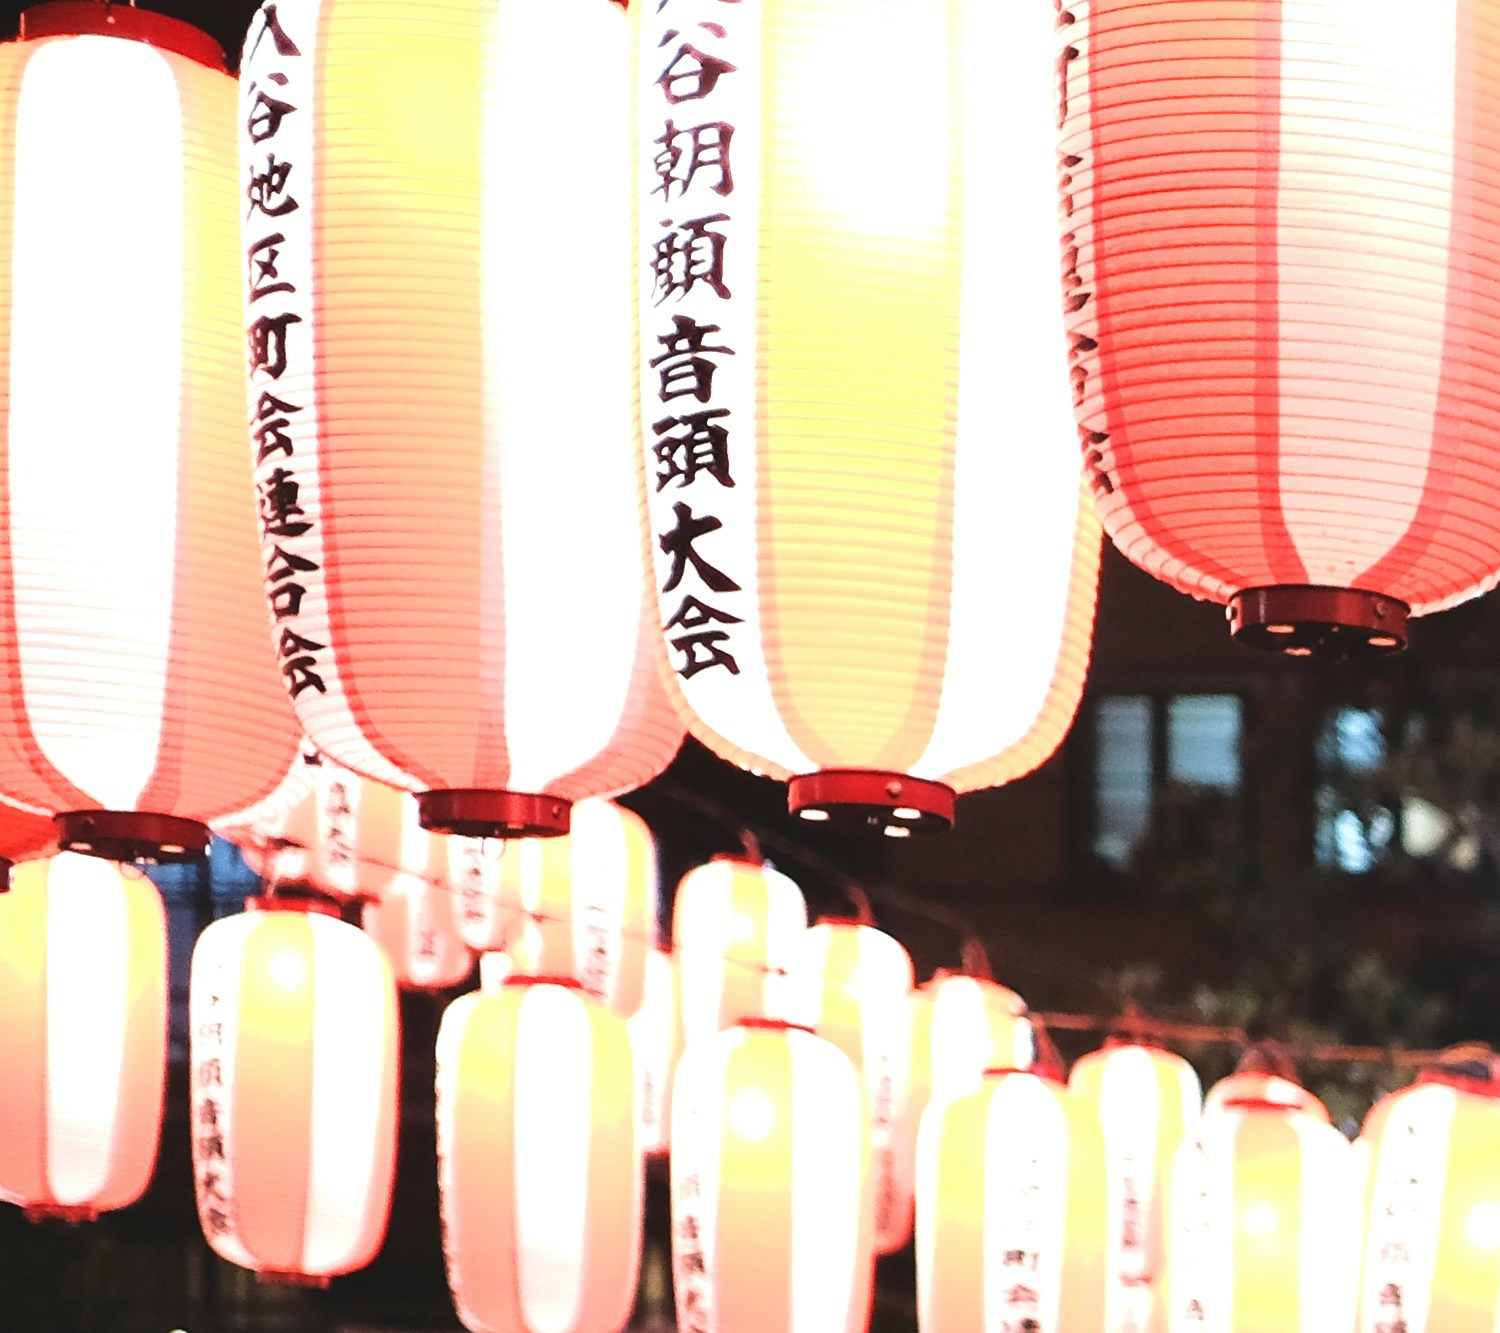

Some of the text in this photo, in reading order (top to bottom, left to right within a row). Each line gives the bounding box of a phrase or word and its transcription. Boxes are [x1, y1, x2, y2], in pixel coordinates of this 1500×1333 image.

[247, 3, 328, 698] 入谷地区町会連合会
[651, 0, 746, 680] 谷朝顔音頭大会
